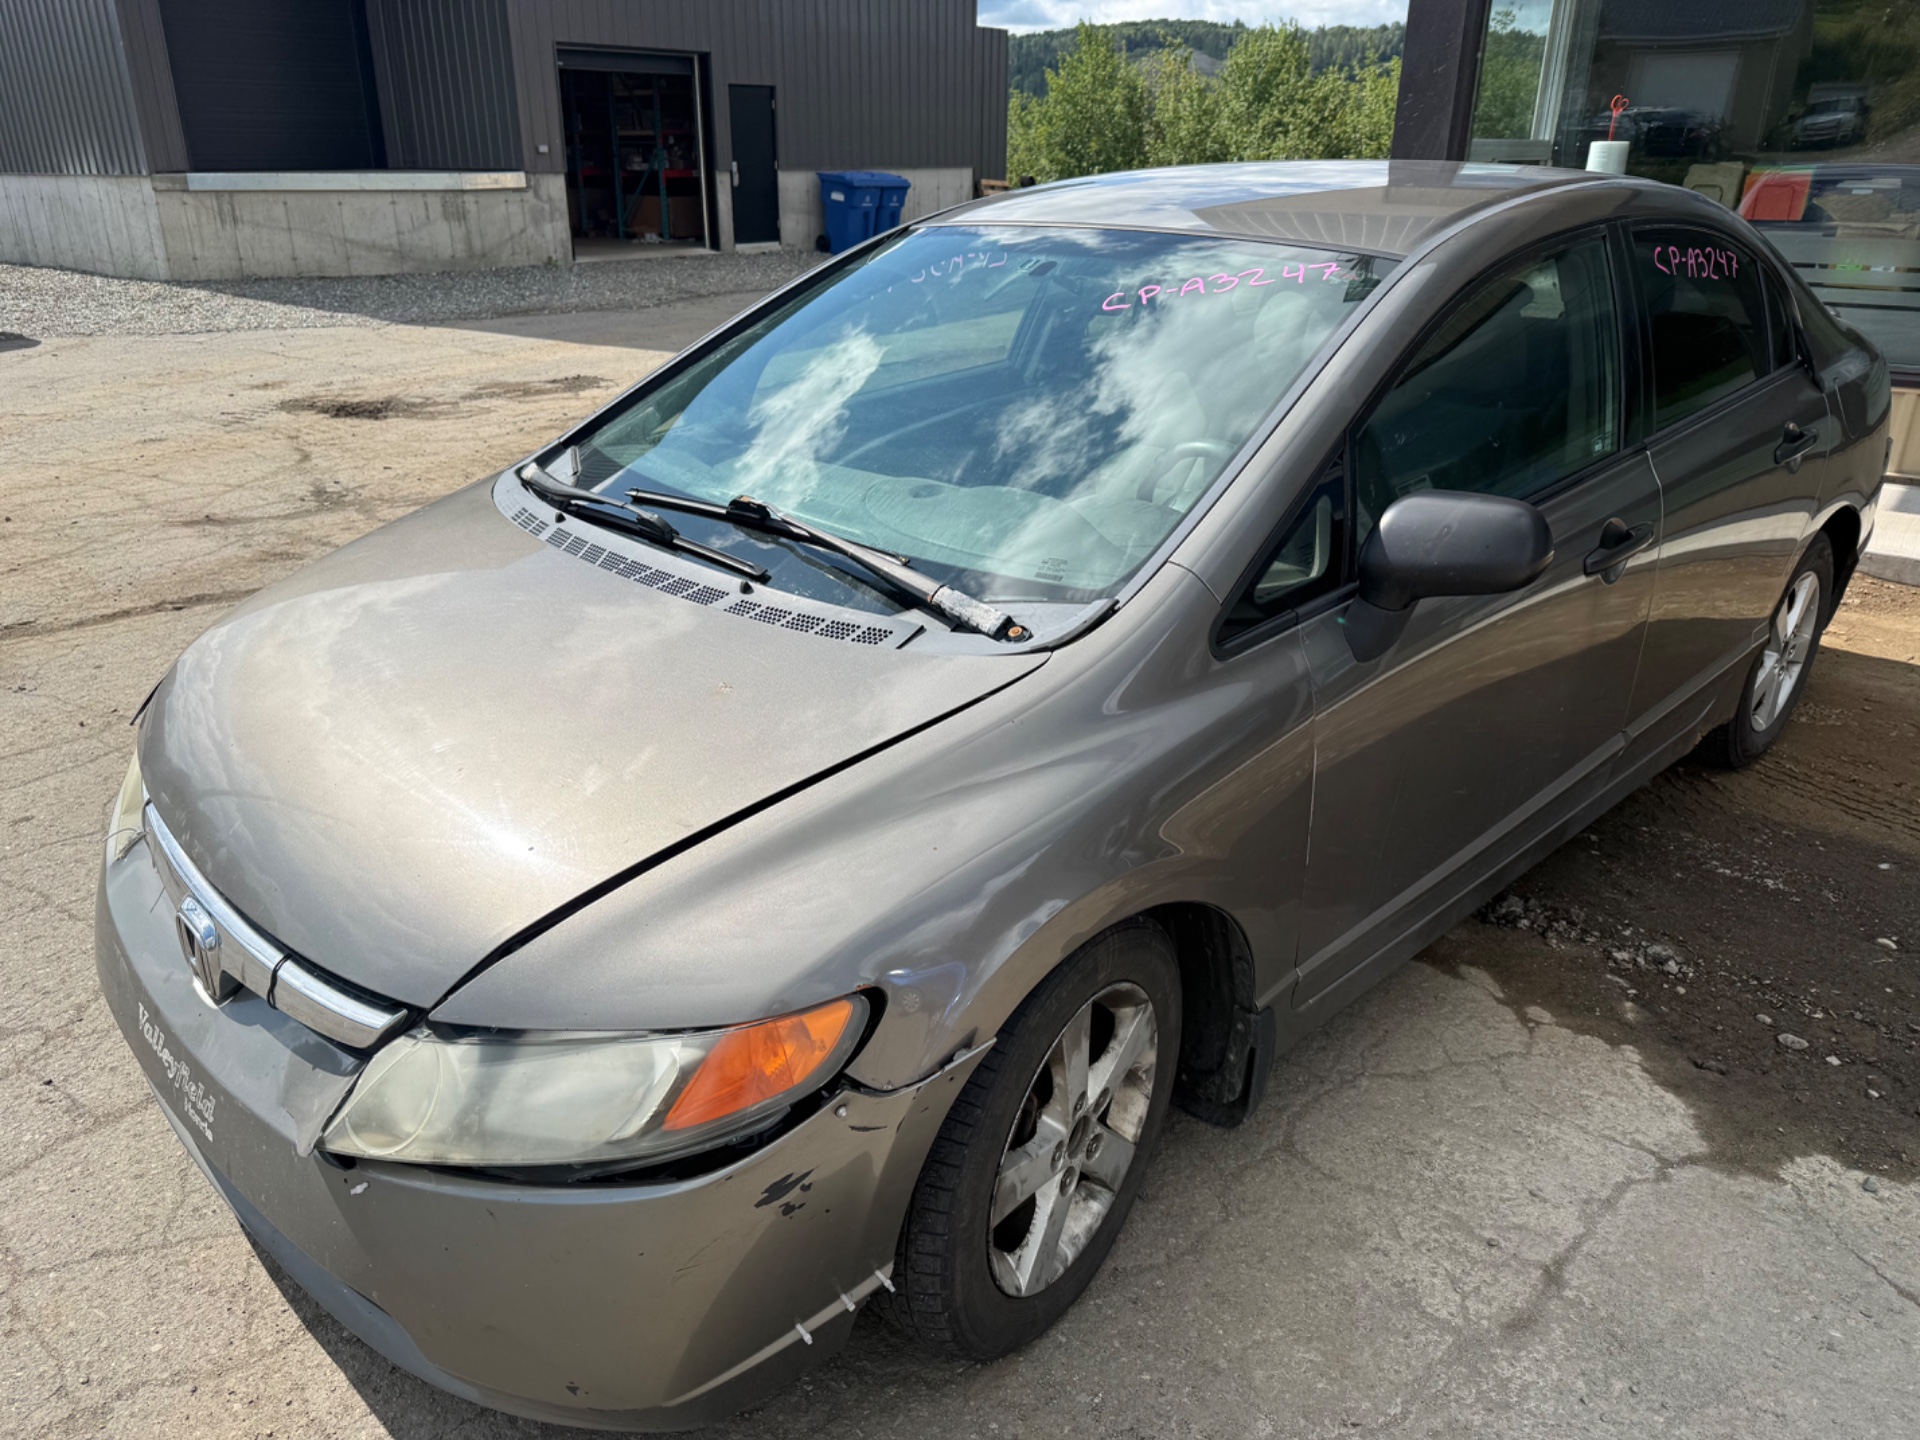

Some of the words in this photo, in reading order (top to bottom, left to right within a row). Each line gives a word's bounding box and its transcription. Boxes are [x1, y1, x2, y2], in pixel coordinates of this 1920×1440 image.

[1102, 262, 1341, 311] CP-A3247
[1654, 246, 1739, 280] CP-A3247
[138, 1001, 215, 1123] Valleyfield
